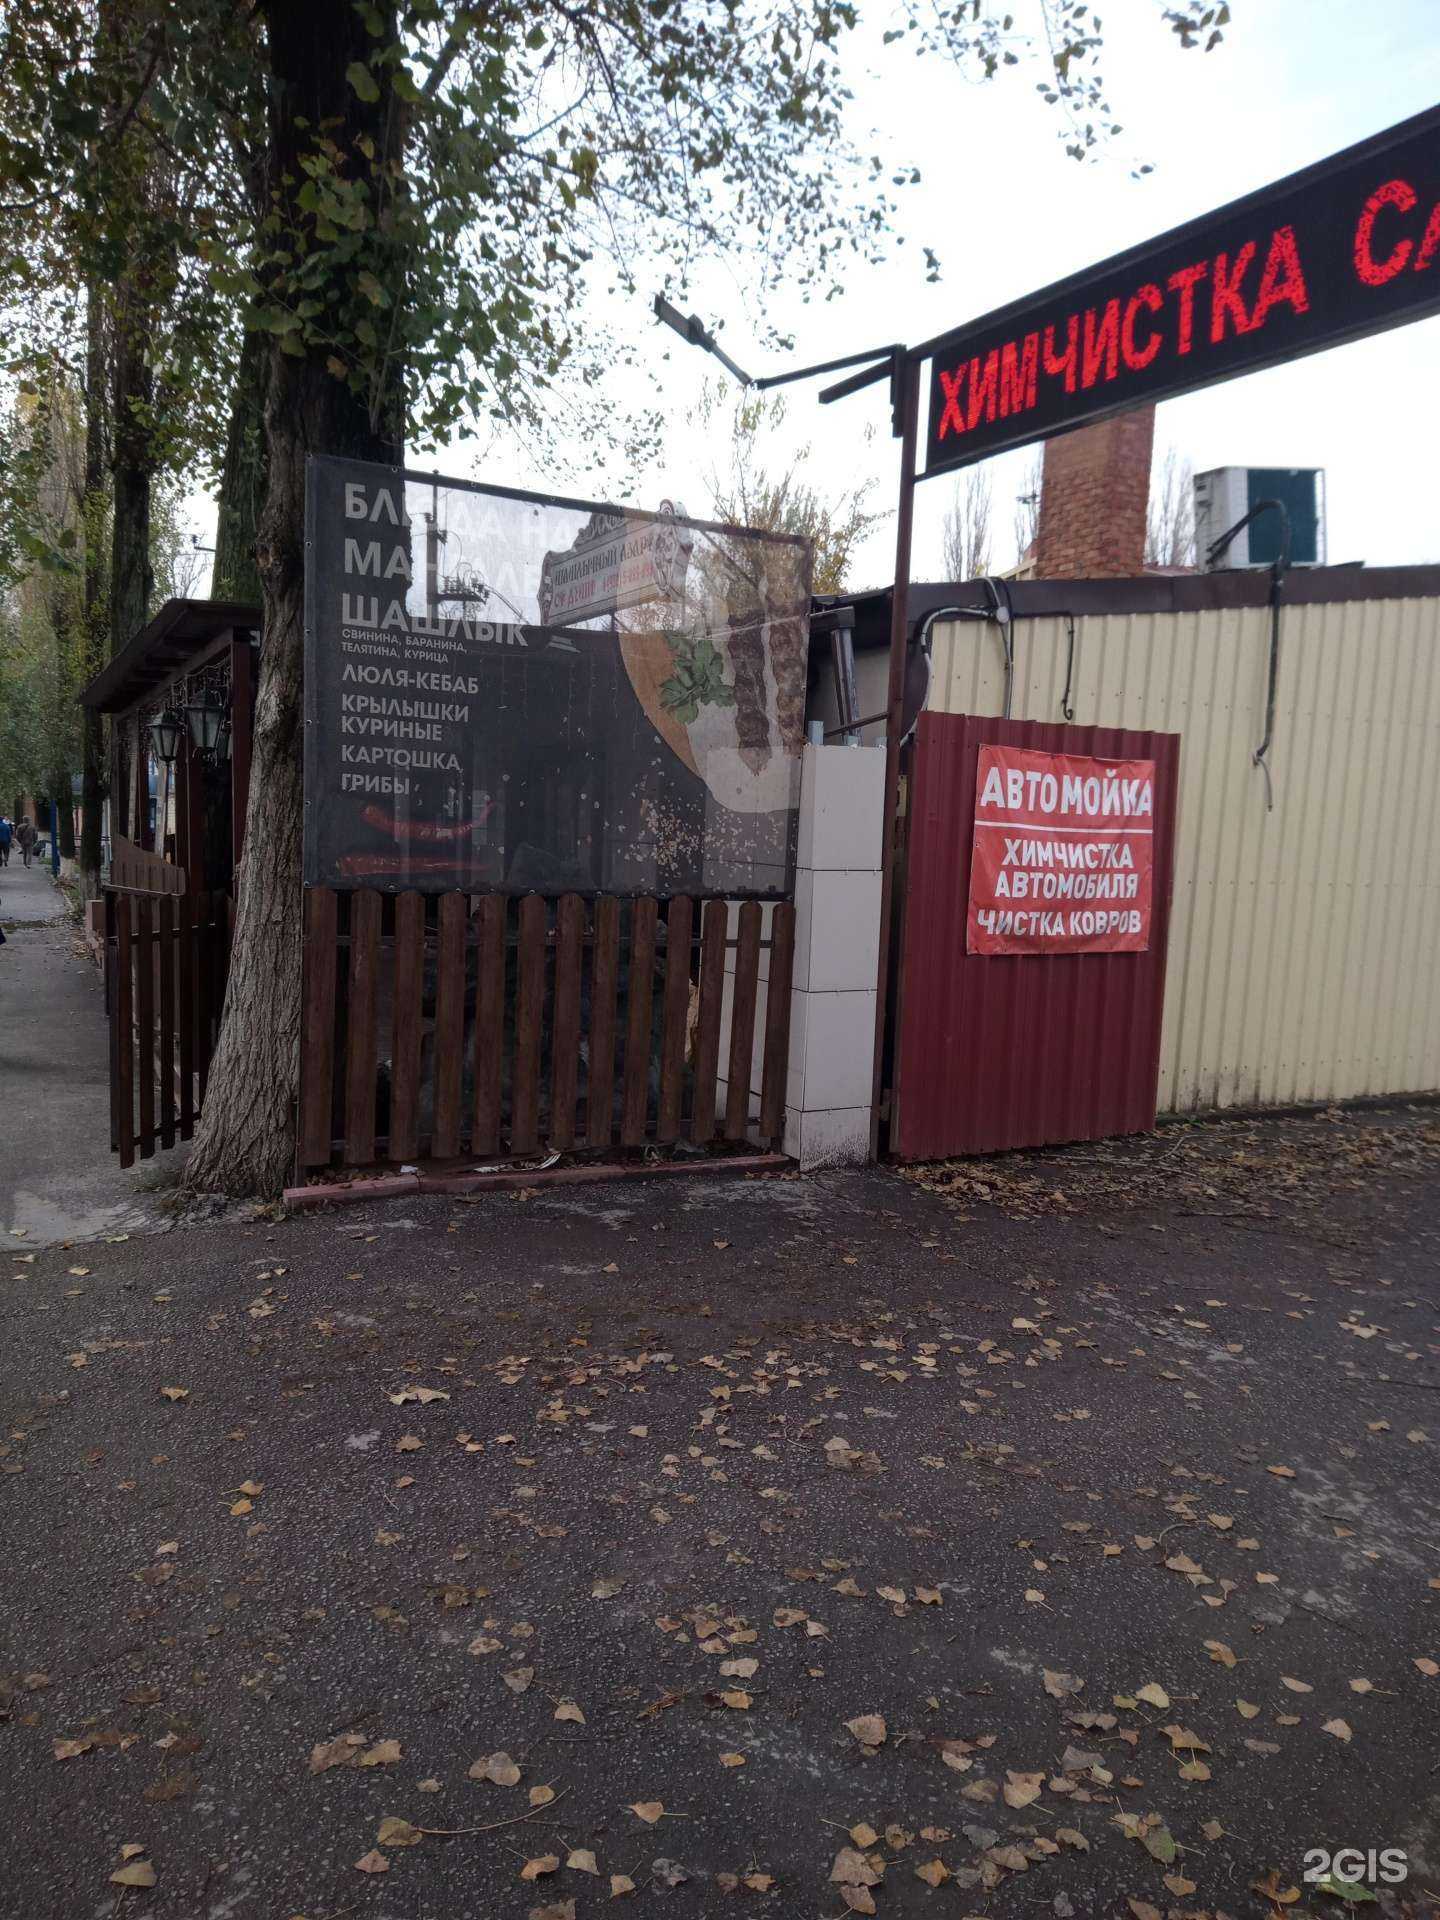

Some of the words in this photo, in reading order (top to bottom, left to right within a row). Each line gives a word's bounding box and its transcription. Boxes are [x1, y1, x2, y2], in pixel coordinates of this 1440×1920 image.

[938, 224, 1309, 440] ХИМЧИСТКА
[342, 628, 401, 646] СВИНИНА,
[405, 635, 468, 653] БАРАНИНА,
[404, 648, 449, 664] КУРИЦА
[342, 663, 479, 694] ЛЮЛЯ-КЕБАБ
[341, 693, 469, 722] КРЫЛЫШКИ
[341, 715, 443, 741] КУРИНЫЕ
[341, 773, 410, 795] ГРИБЫ
[980, 767, 1152, 817] АВТОМОЙКА
[1002, 838, 1135, 869] ХИМЧИСТКА
[994, 870, 1139, 900] АВТОМОБИЛЯ
[977, 909, 1066, 936] ЧИСТКА
[1069, 909, 1143, 936] КОВРОВ
